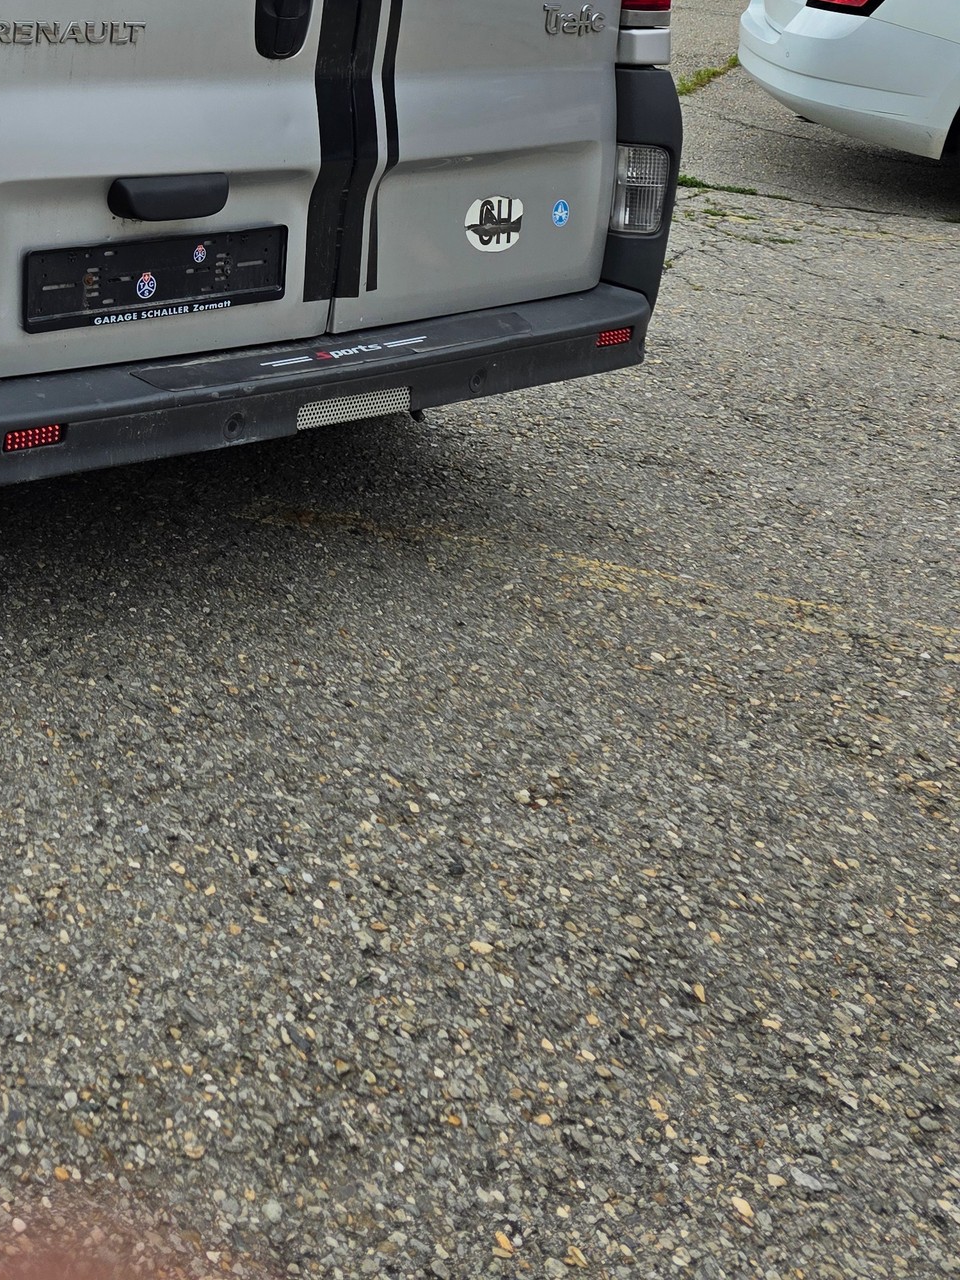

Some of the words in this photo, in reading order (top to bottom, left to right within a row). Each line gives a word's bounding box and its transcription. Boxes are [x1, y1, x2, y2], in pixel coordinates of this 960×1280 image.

[543, 3, 606, 37] Trafic
[94, 312, 138, 325] GARAGE
[141, 305, 190, 319] SCHALLER
[193, 300, 232, 312] Zermatt
[315, 342, 383, 361] Sports
